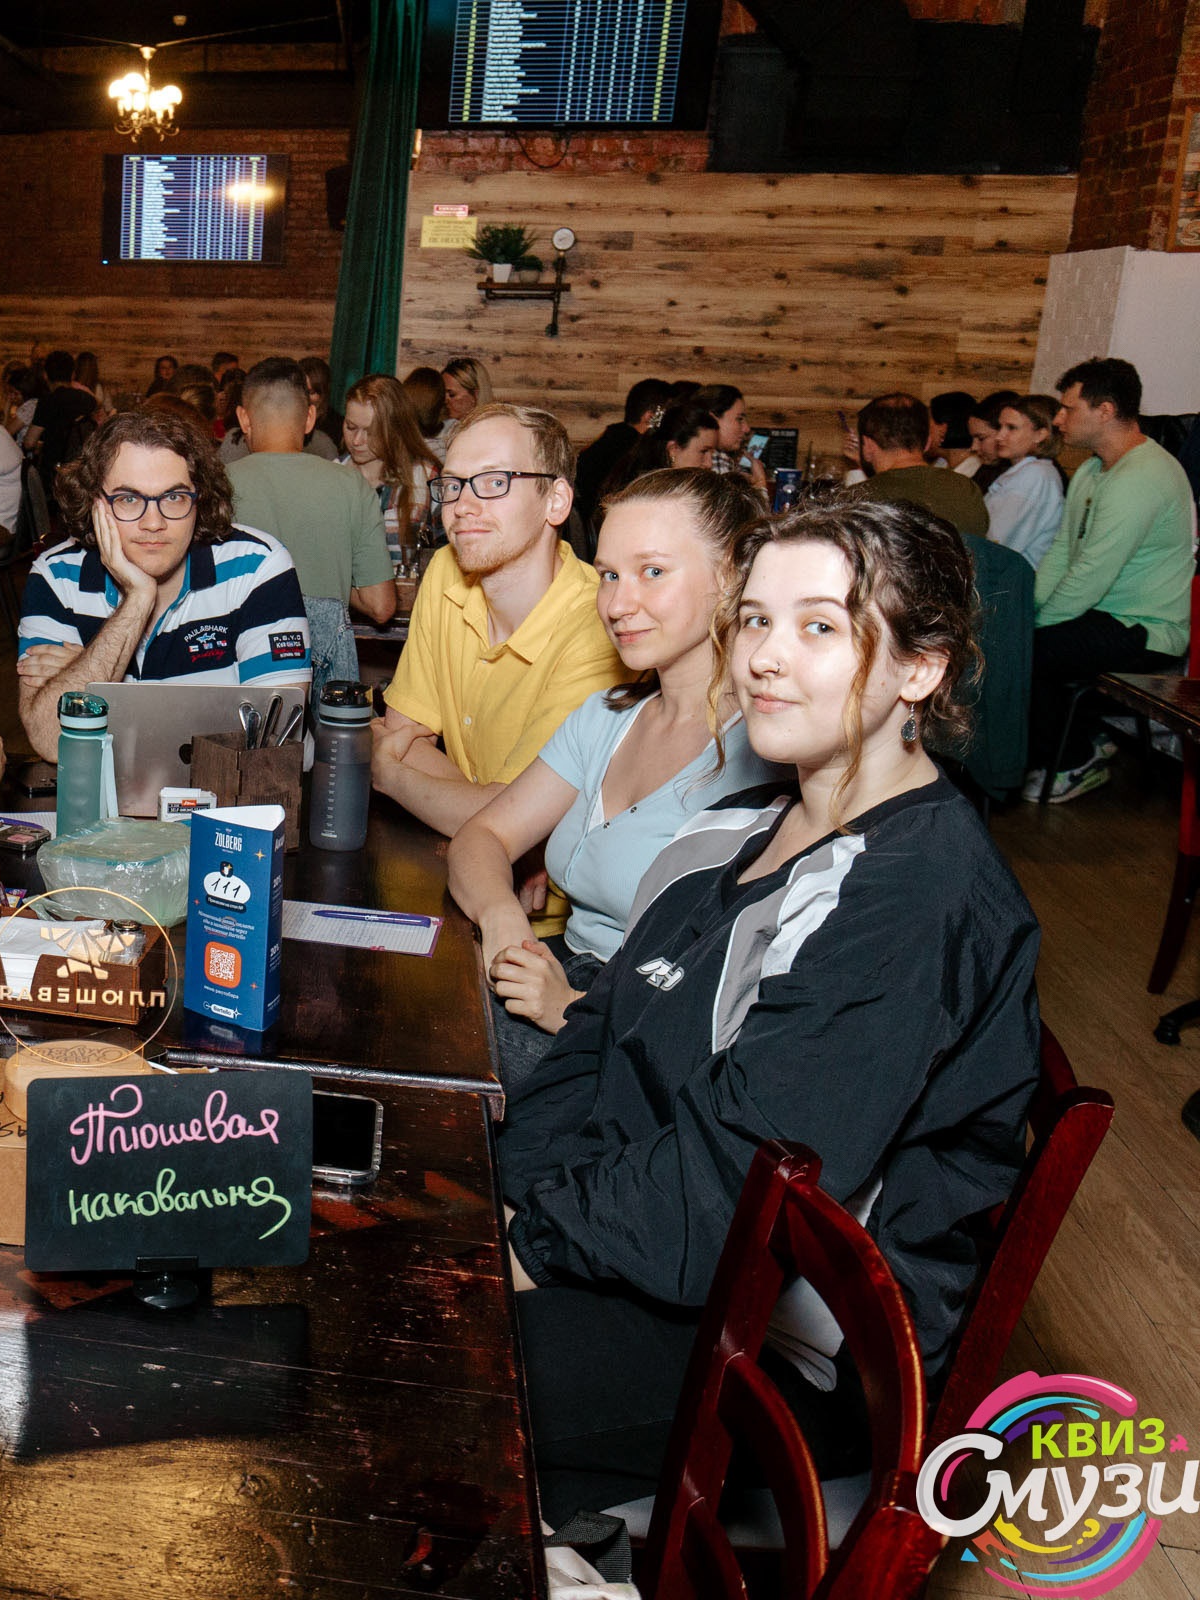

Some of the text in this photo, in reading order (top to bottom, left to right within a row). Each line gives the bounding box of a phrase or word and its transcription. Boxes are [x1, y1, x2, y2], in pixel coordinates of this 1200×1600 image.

[214, 831, 243, 852] ZOLBERG
[70, 1084, 279, 1165] Плюшевая
[68, 1168, 292, 1240] наковальня
